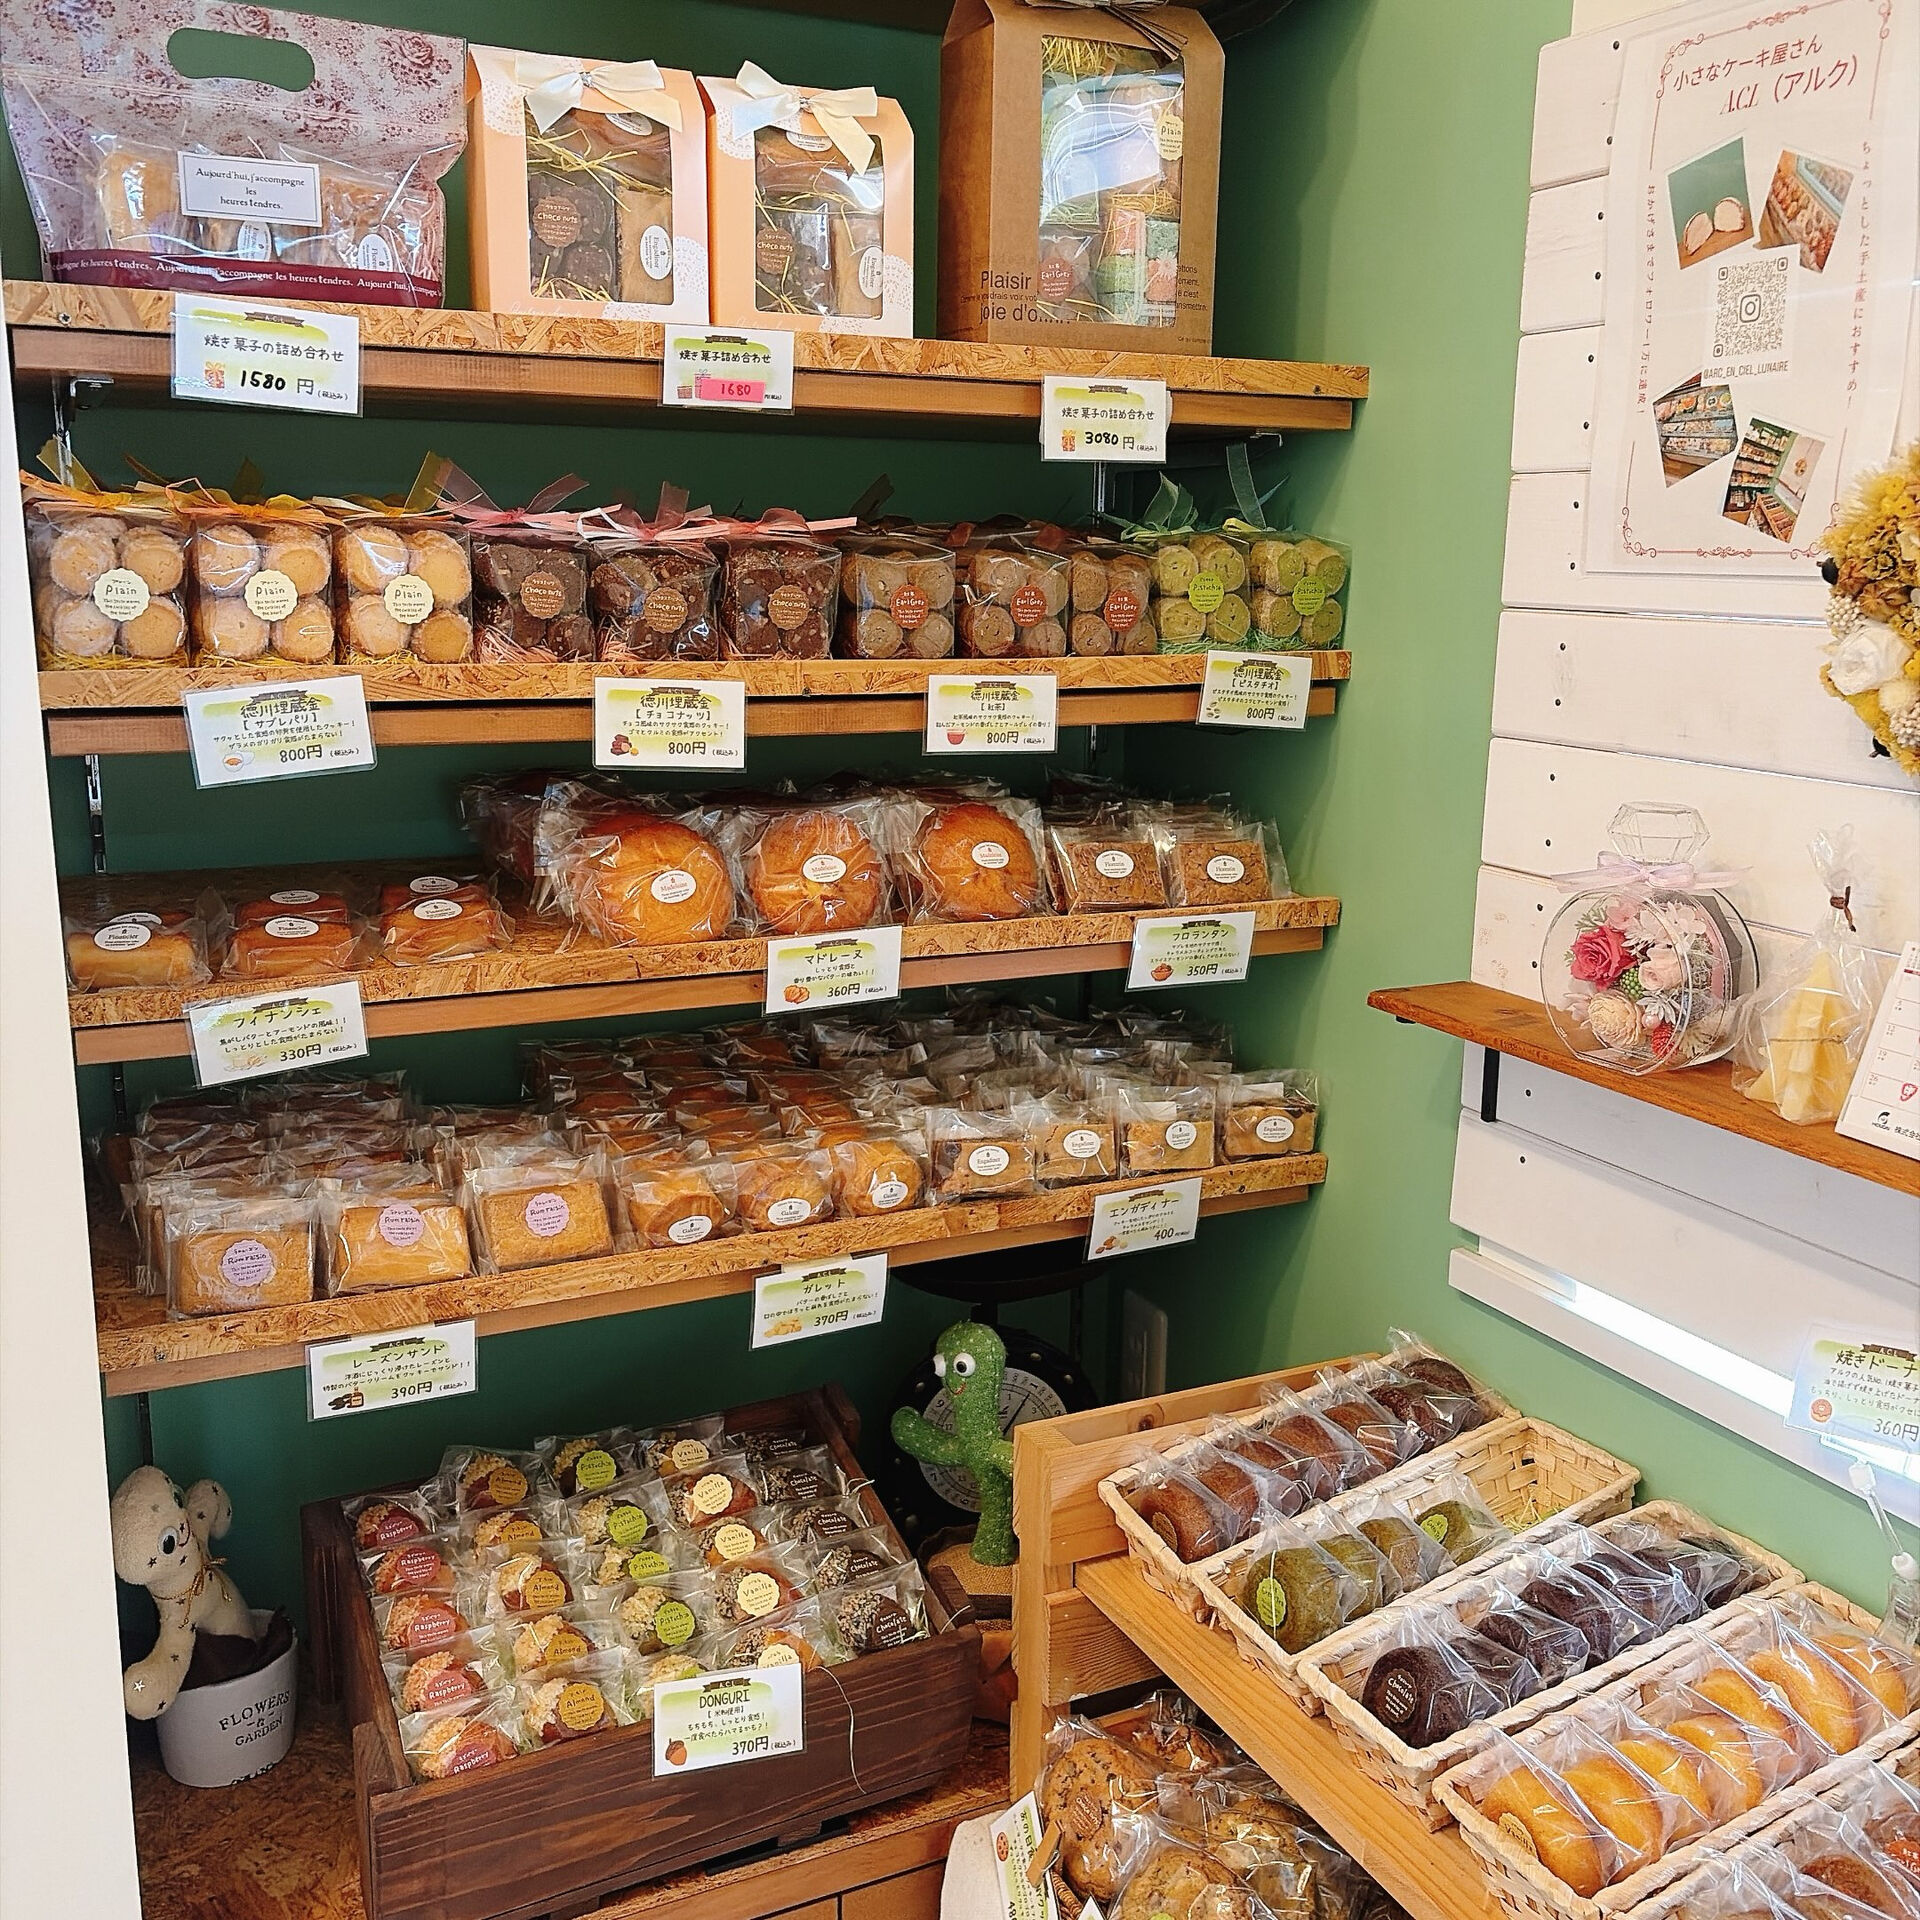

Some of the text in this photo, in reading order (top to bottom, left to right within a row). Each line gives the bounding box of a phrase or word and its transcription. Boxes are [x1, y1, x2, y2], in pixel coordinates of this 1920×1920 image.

[1674, 34, 1823, 91] 小さなケーキ屋さん
[1161, 125, 1182, 136] Plain
[245, 187, 257, 196] les
[220, 196, 283, 210] heures tendres.
[114, 259, 153, 271] tendres.
[275, 271, 287, 281] les
[289, 273, 317, 283] heures
[318, 275, 353, 287] tendres.
[980, 271, 1032, 290] Plaisir
[980, 302, 1007, 325] joie
[203, 334, 345, 363] 焼き菓子の詰め合わせ
[679, 350, 772, 364] 焼き菓子詰め合わせ
[1703, 360, 1789, 380] @ARC_EN_CIEL_LUNAIRE
[241, 369, 287, 391] 1580
[297, 378, 315, 395] 円
[721, 383, 751, 396] 1680
[1062, 406, 1154, 420] 焼き菓子の詰め合わせ
[1085, 431, 1119, 445] 3080
[1123, 436, 1135, 450] 円
[105, 584, 137, 595] Plain
[256, 586, 285, 597] Plain
[395, 589, 423, 599] Plain
[1233, 666, 1284, 681] 徳川埋蔵金
[641, 696, 712, 710] 徳川埋蔵金
[970, 690, 1021, 701] 徳川埋蔵金
[240, 697, 322, 718] 徳川埋蔵金
[1246, 707, 1275, 719] 800円
[987, 731, 1019, 744] 800円
[279, 744, 323, 763] 800円
[668, 741, 706, 755] 800円
[1172, 929, 1229, 942] フロランタン
[804, 949, 864, 964] マドレーヌ
[1187, 963, 1219, 977] 350円
[827, 983, 861, 998] 360円
[233, 1006, 322, 1029] フィナンシェ
[280, 1043, 322, 1062] 330円
[1110, 1198, 1180, 1218] エンガディナー
[1154, 1227, 1174, 1241] 400
[803, 1279, 846, 1294] ガレット
[814, 1310, 848, 1327] 370円
[353, 1344, 446, 1369] レーズンサンド
[391, 1381, 433, 1399] 390円
[1873, 1418, 1920, 1443] 360円
[677, 1448, 703, 1458] Vanilla
[790, 1475, 817, 1486] Chocolate
[698, 1481, 725, 1498] Vanilla
[818, 1516, 847, 1525] Chocolate
[380, 1524, 413, 1540] Raspberry
[508, 1531, 535, 1540] Almond
[720, 1531, 749, 1542] Vanilla
[400, 1554, 435, 1566] Raspberry
[850, 1560, 879, 1571] Chocolate
[533, 1584, 559, 1592] Almond
[742, 1583, 772, 1597] Vanilla
[414, 1618, 450, 1632] Raspberry
[876, 1615, 908, 1633] Chocolate
[553, 1645, 582, 1656] Almond
[429, 1682, 466, 1700] Raspberry
[1388, 1677, 1414, 1704] Chocolate
[566, 1695, 596, 1709] Almond
[699, 1689, 751, 1709] DONGURI
[219, 1690, 290, 1731] FLOWERS
[235, 1715, 283, 1746] GARDEN
[732, 1735, 769, 1756] 370円
[453, 1752, 489, 1775] Raspberry
